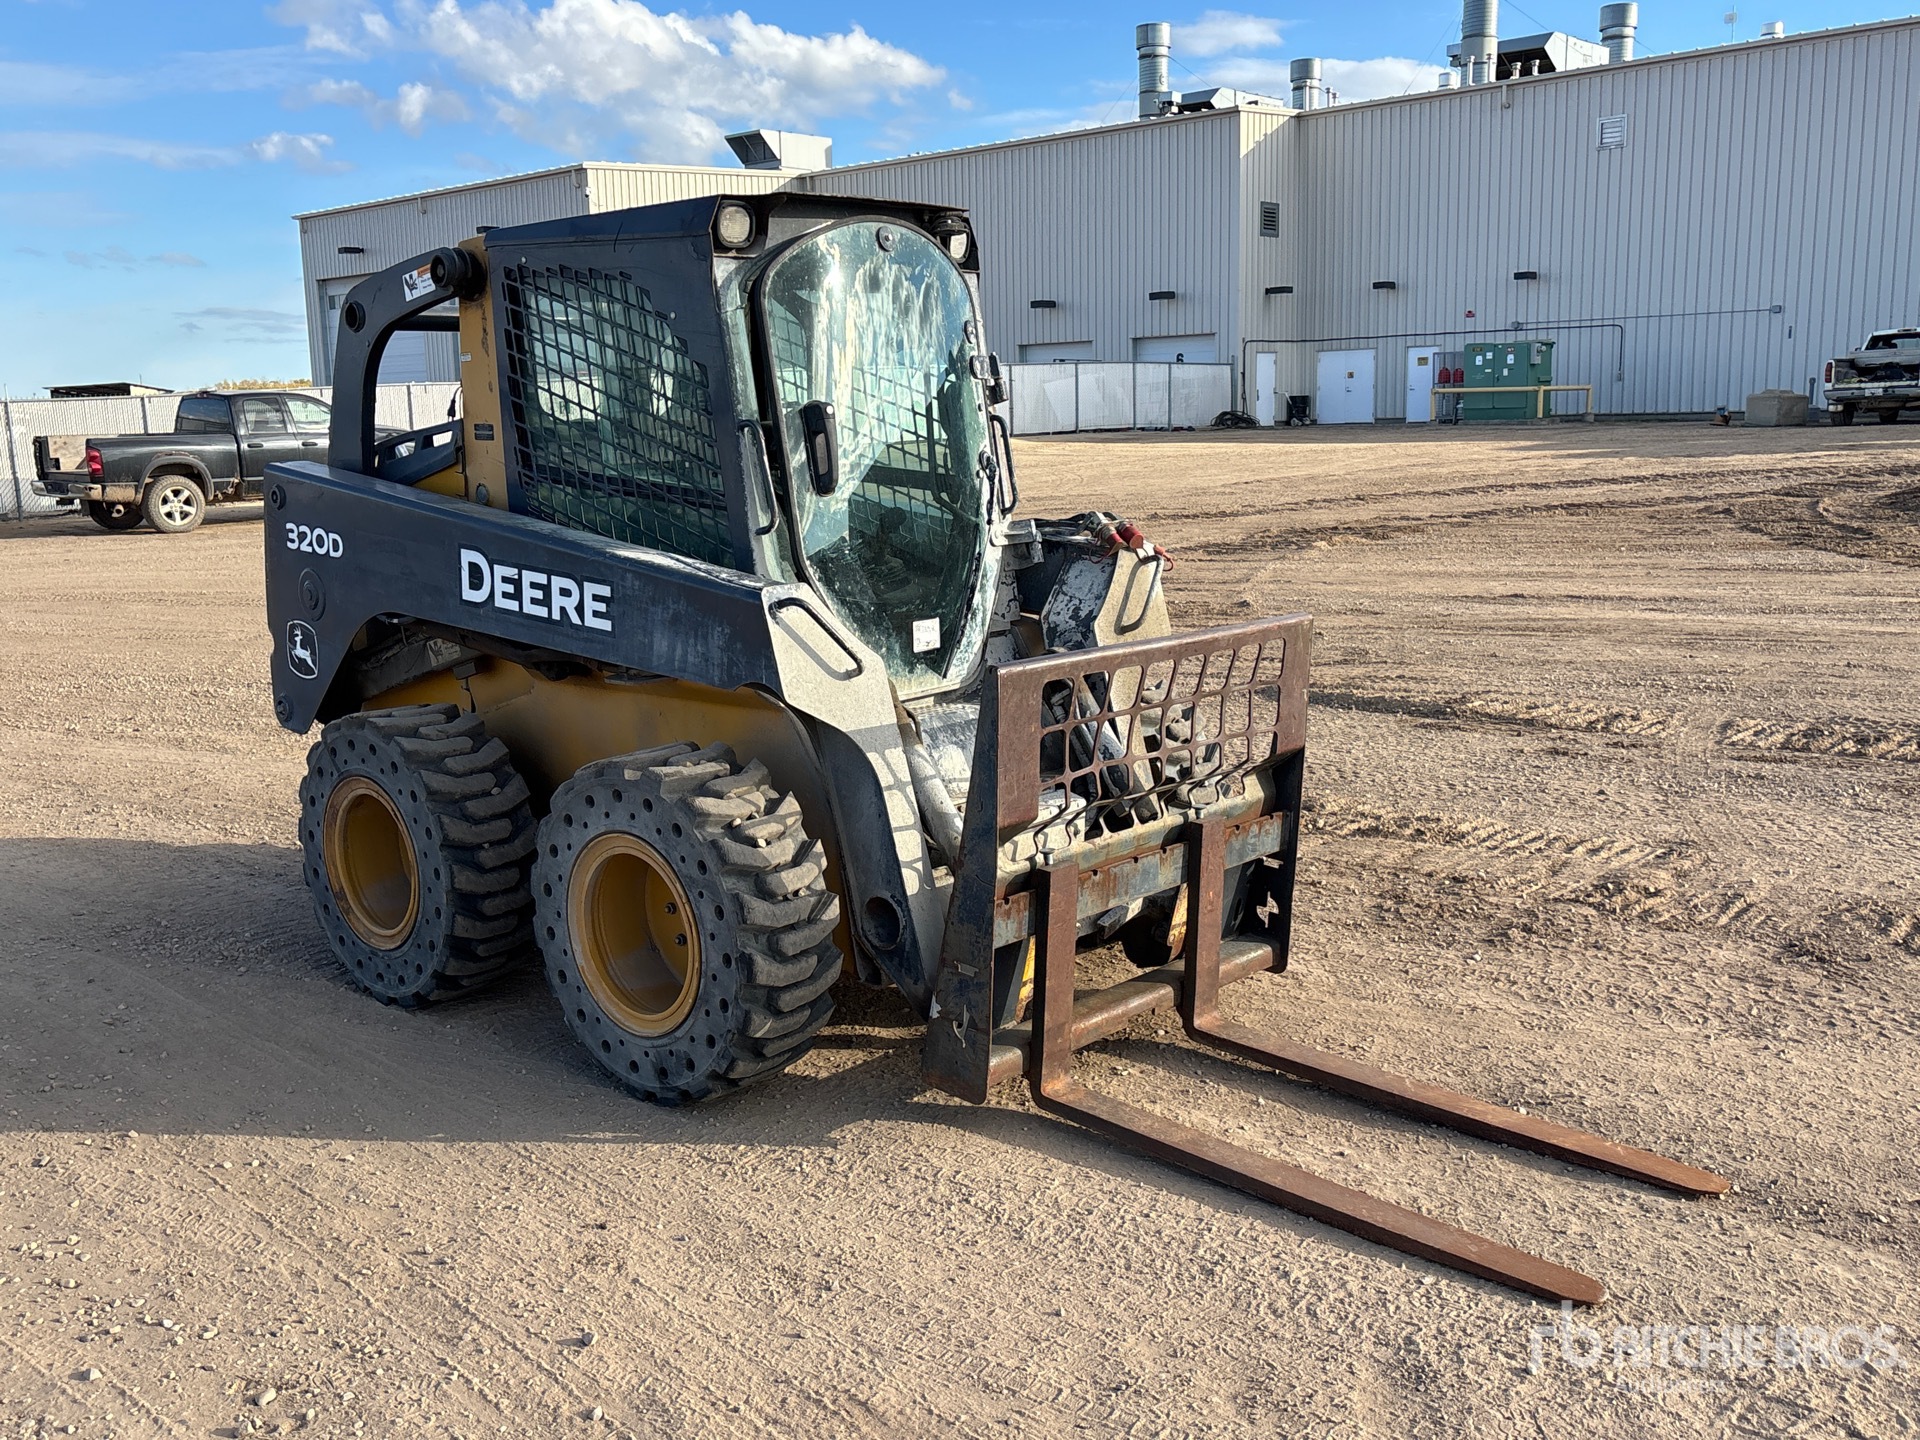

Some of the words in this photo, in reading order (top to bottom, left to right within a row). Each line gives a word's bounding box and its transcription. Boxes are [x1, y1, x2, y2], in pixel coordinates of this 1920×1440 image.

[1176, 352, 1184, 363] 6
[285, 522, 343, 558] 320D
[460, 548, 612, 632] DEERE
